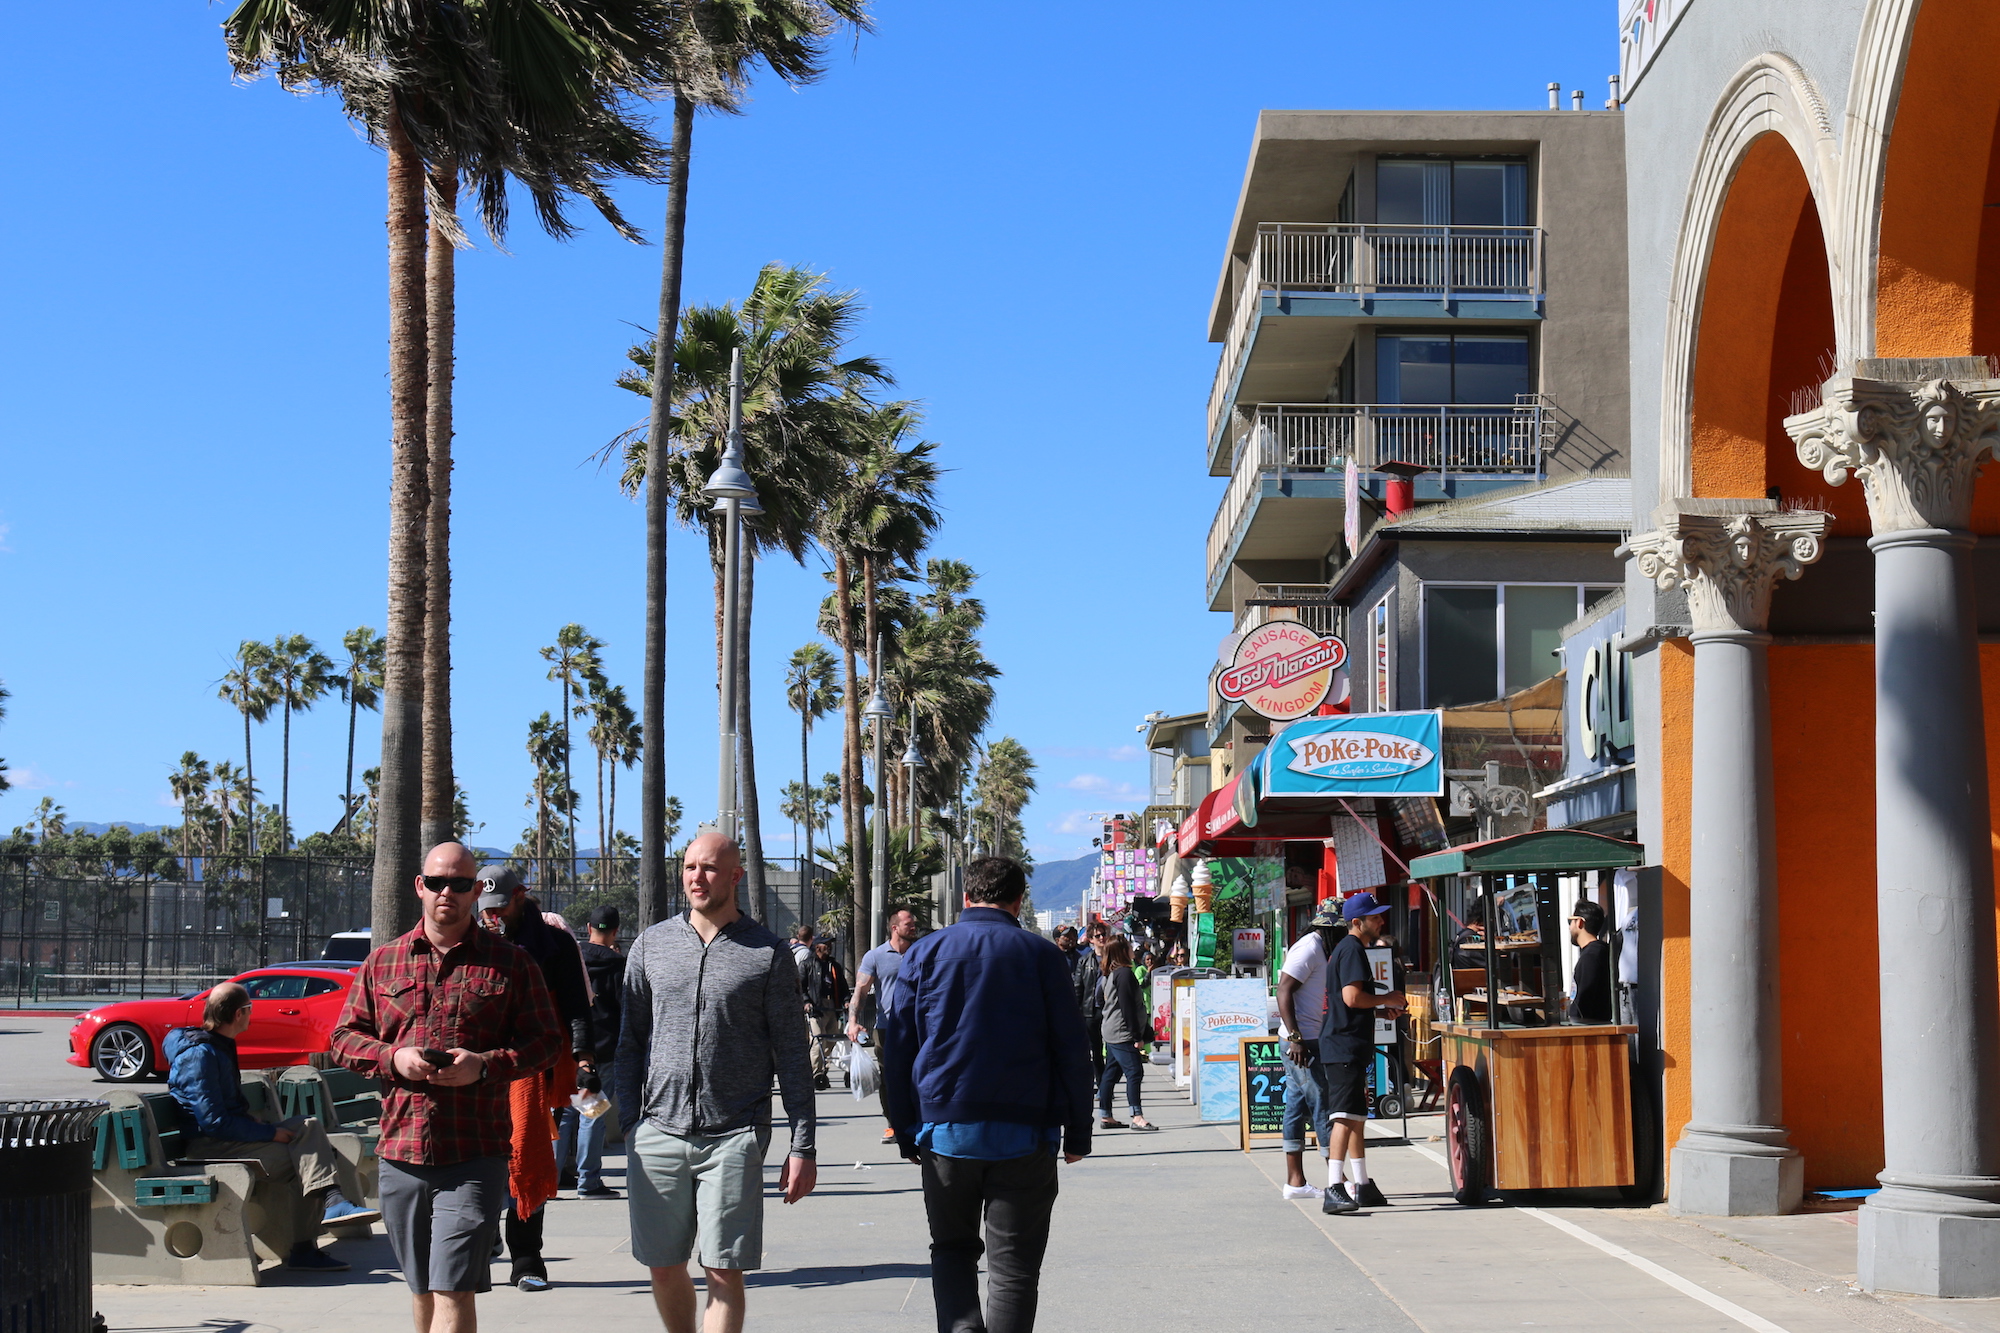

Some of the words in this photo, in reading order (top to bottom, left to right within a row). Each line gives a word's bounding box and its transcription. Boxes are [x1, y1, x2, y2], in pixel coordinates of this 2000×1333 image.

[1244, 628, 1310, 660] SAUSAGE
[1224, 661, 1273, 693] Jody
[1268, 640, 1339, 681] Maroni's
[1256, 681, 1324, 713] KINGDOM
[1328, 765, 1340, 776] the
[1340, 763, 1370, 777] Surfer's
[1371, 762, 1399, 774] Sashimi
[1237, 932, 1261, 941] ATM
[1249, 1043, 1280, 1058] SAL
[1251, 1074, 1270, 1104] 2
